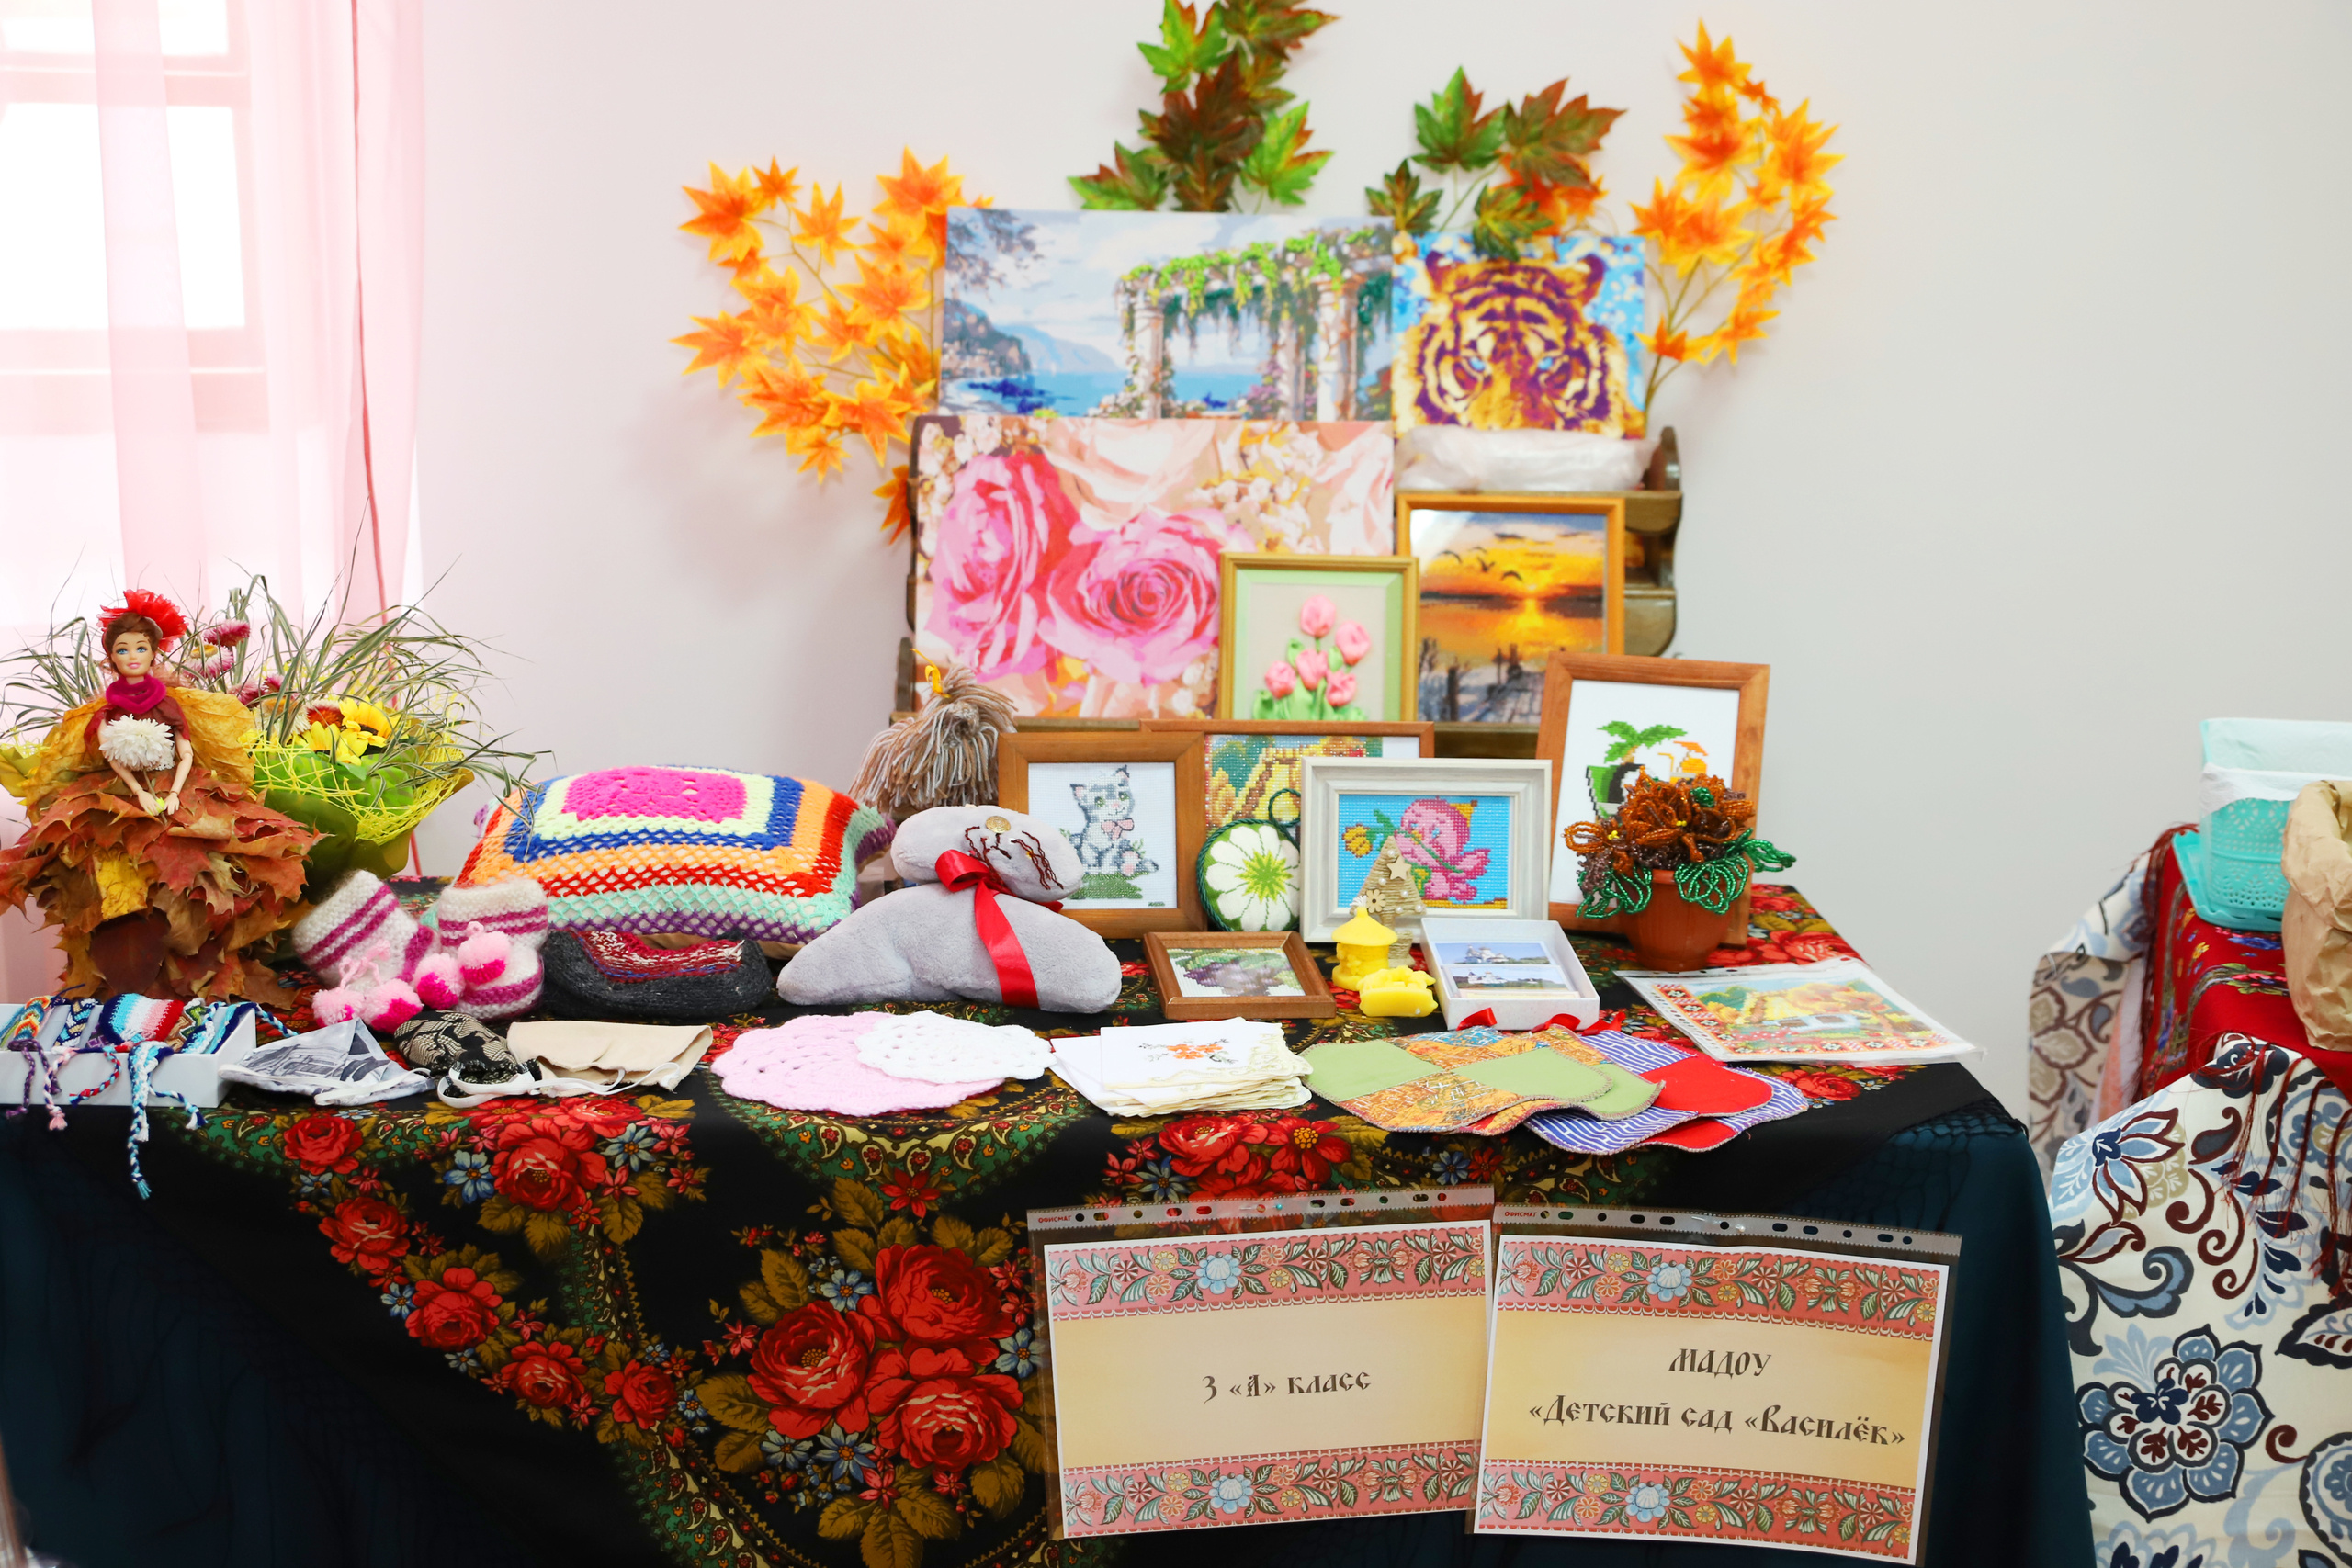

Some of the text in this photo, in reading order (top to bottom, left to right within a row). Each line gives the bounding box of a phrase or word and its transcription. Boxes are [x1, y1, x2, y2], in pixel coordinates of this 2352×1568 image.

[1668, 1348, 1772, 1380] МАДОУ
[1202, 1371, 1371, 1404] 3 «А» класс
[1529, 1394, 1905, 1446] «Детский сад «Василёк»
